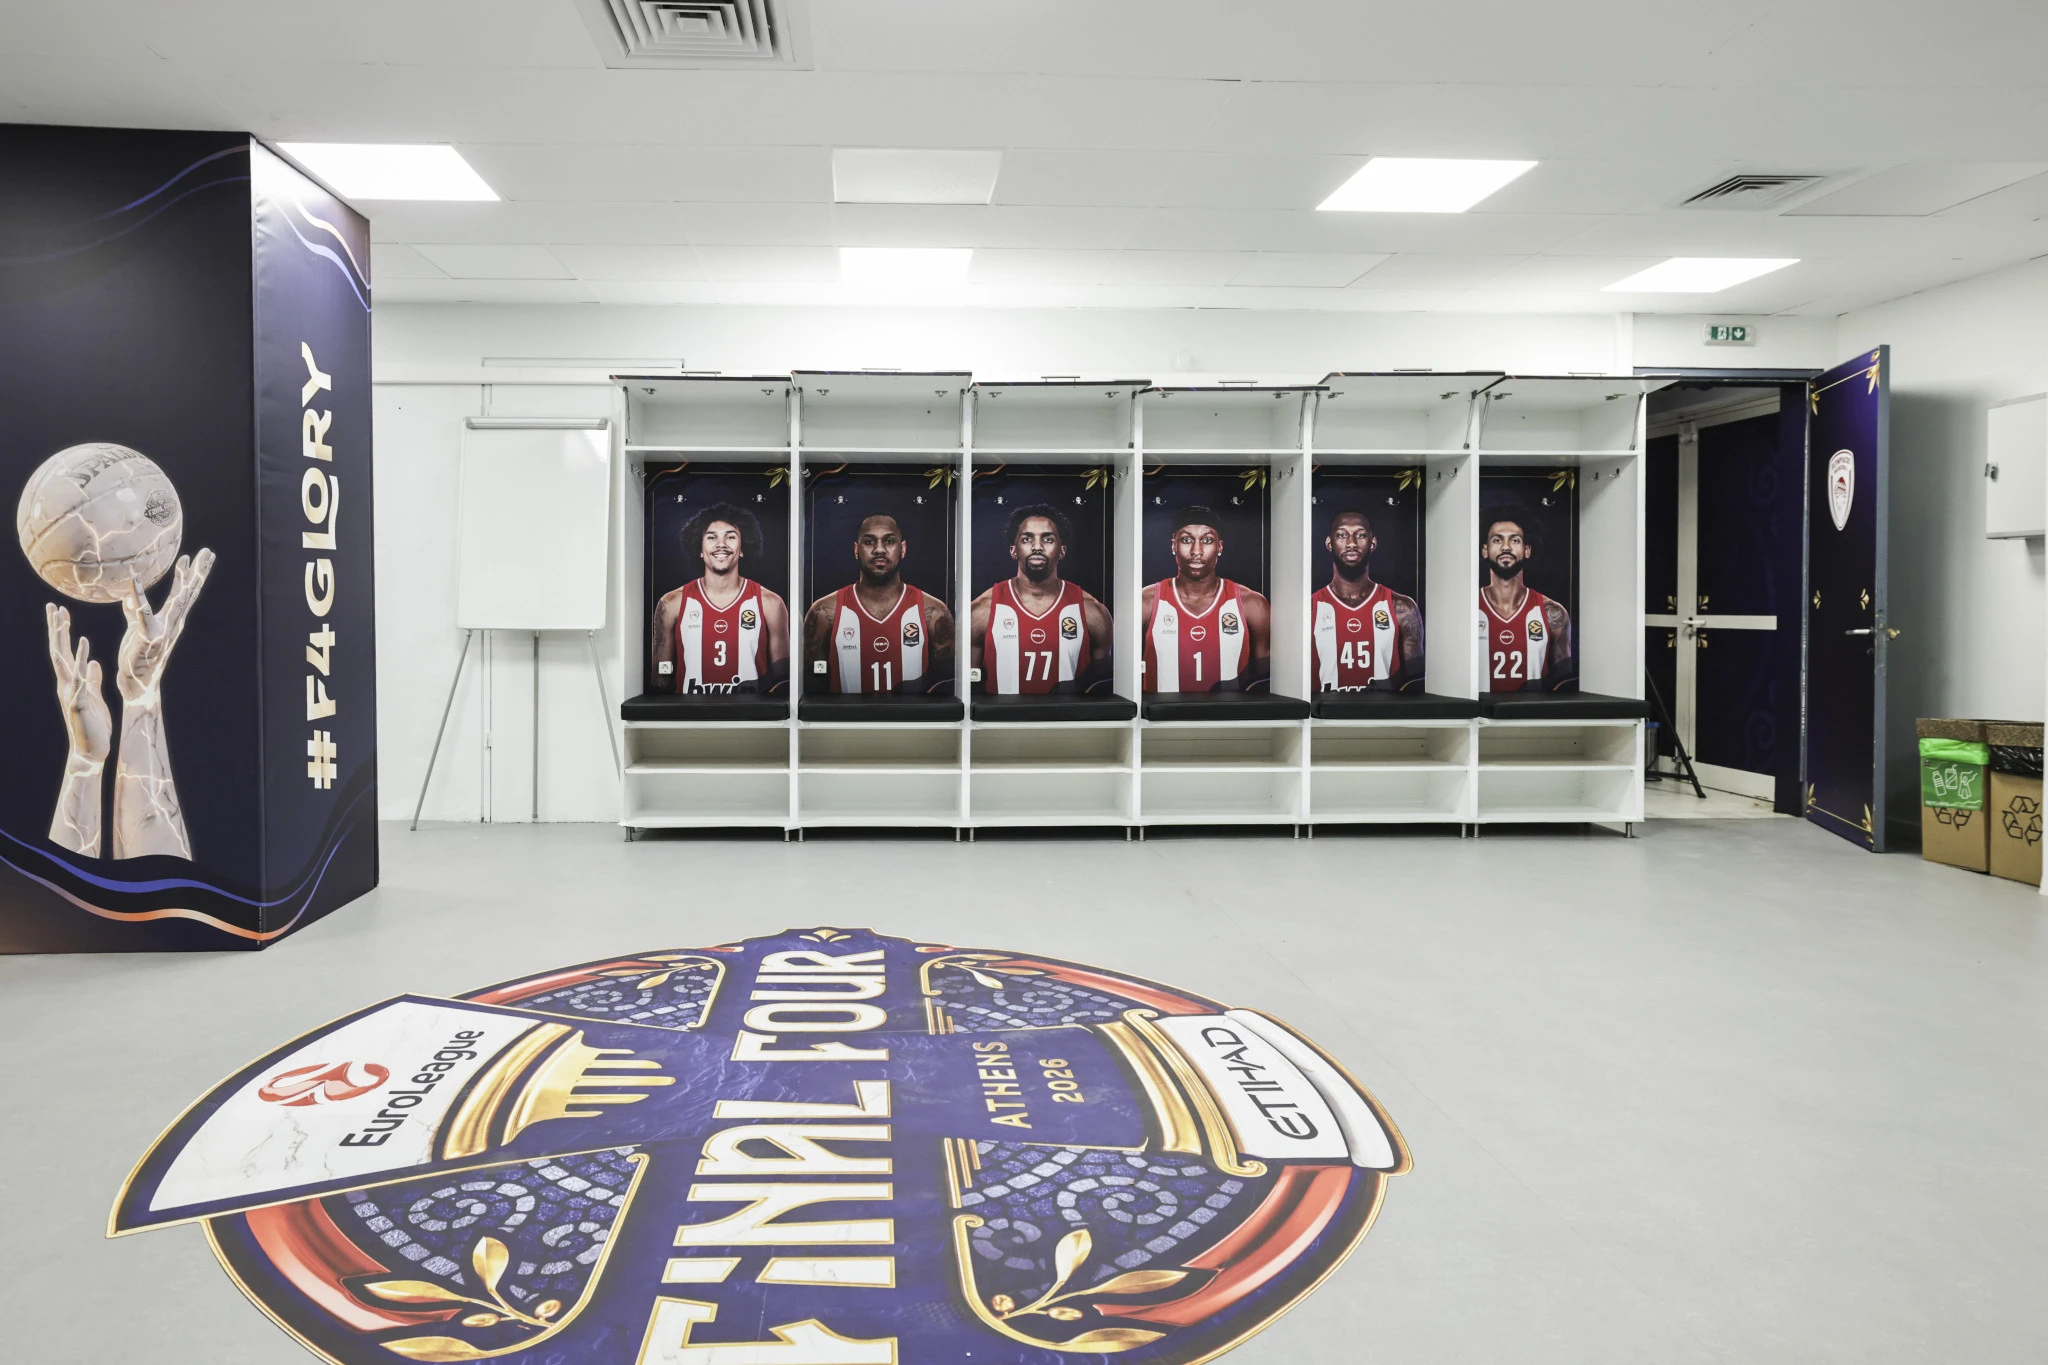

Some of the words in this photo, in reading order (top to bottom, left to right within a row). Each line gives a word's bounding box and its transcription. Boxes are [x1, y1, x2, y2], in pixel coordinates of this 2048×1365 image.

[301, 341, 340, 790] #F4GLORY
[713, 640, 727, 667] 3
[871, 661, 892, 691] 11
[1024, 651, 1053, 681] 77
[1193, 651, 1202, 681] 1
[1340, 640, 1371, 669] 45
[1493, 650, 1523, 679] 22
[730, 949, 889, 1062] FOUR
[338, 1029, 486, 1148] EuroLeague
[972, 1040, 1033, 1130] ATHENS
[1037, 1057, 1085, 1104] 2026
[1200, 1026, 1319, 1141] ETIHAD
[633, 1079, 899, 1365] FINAL
